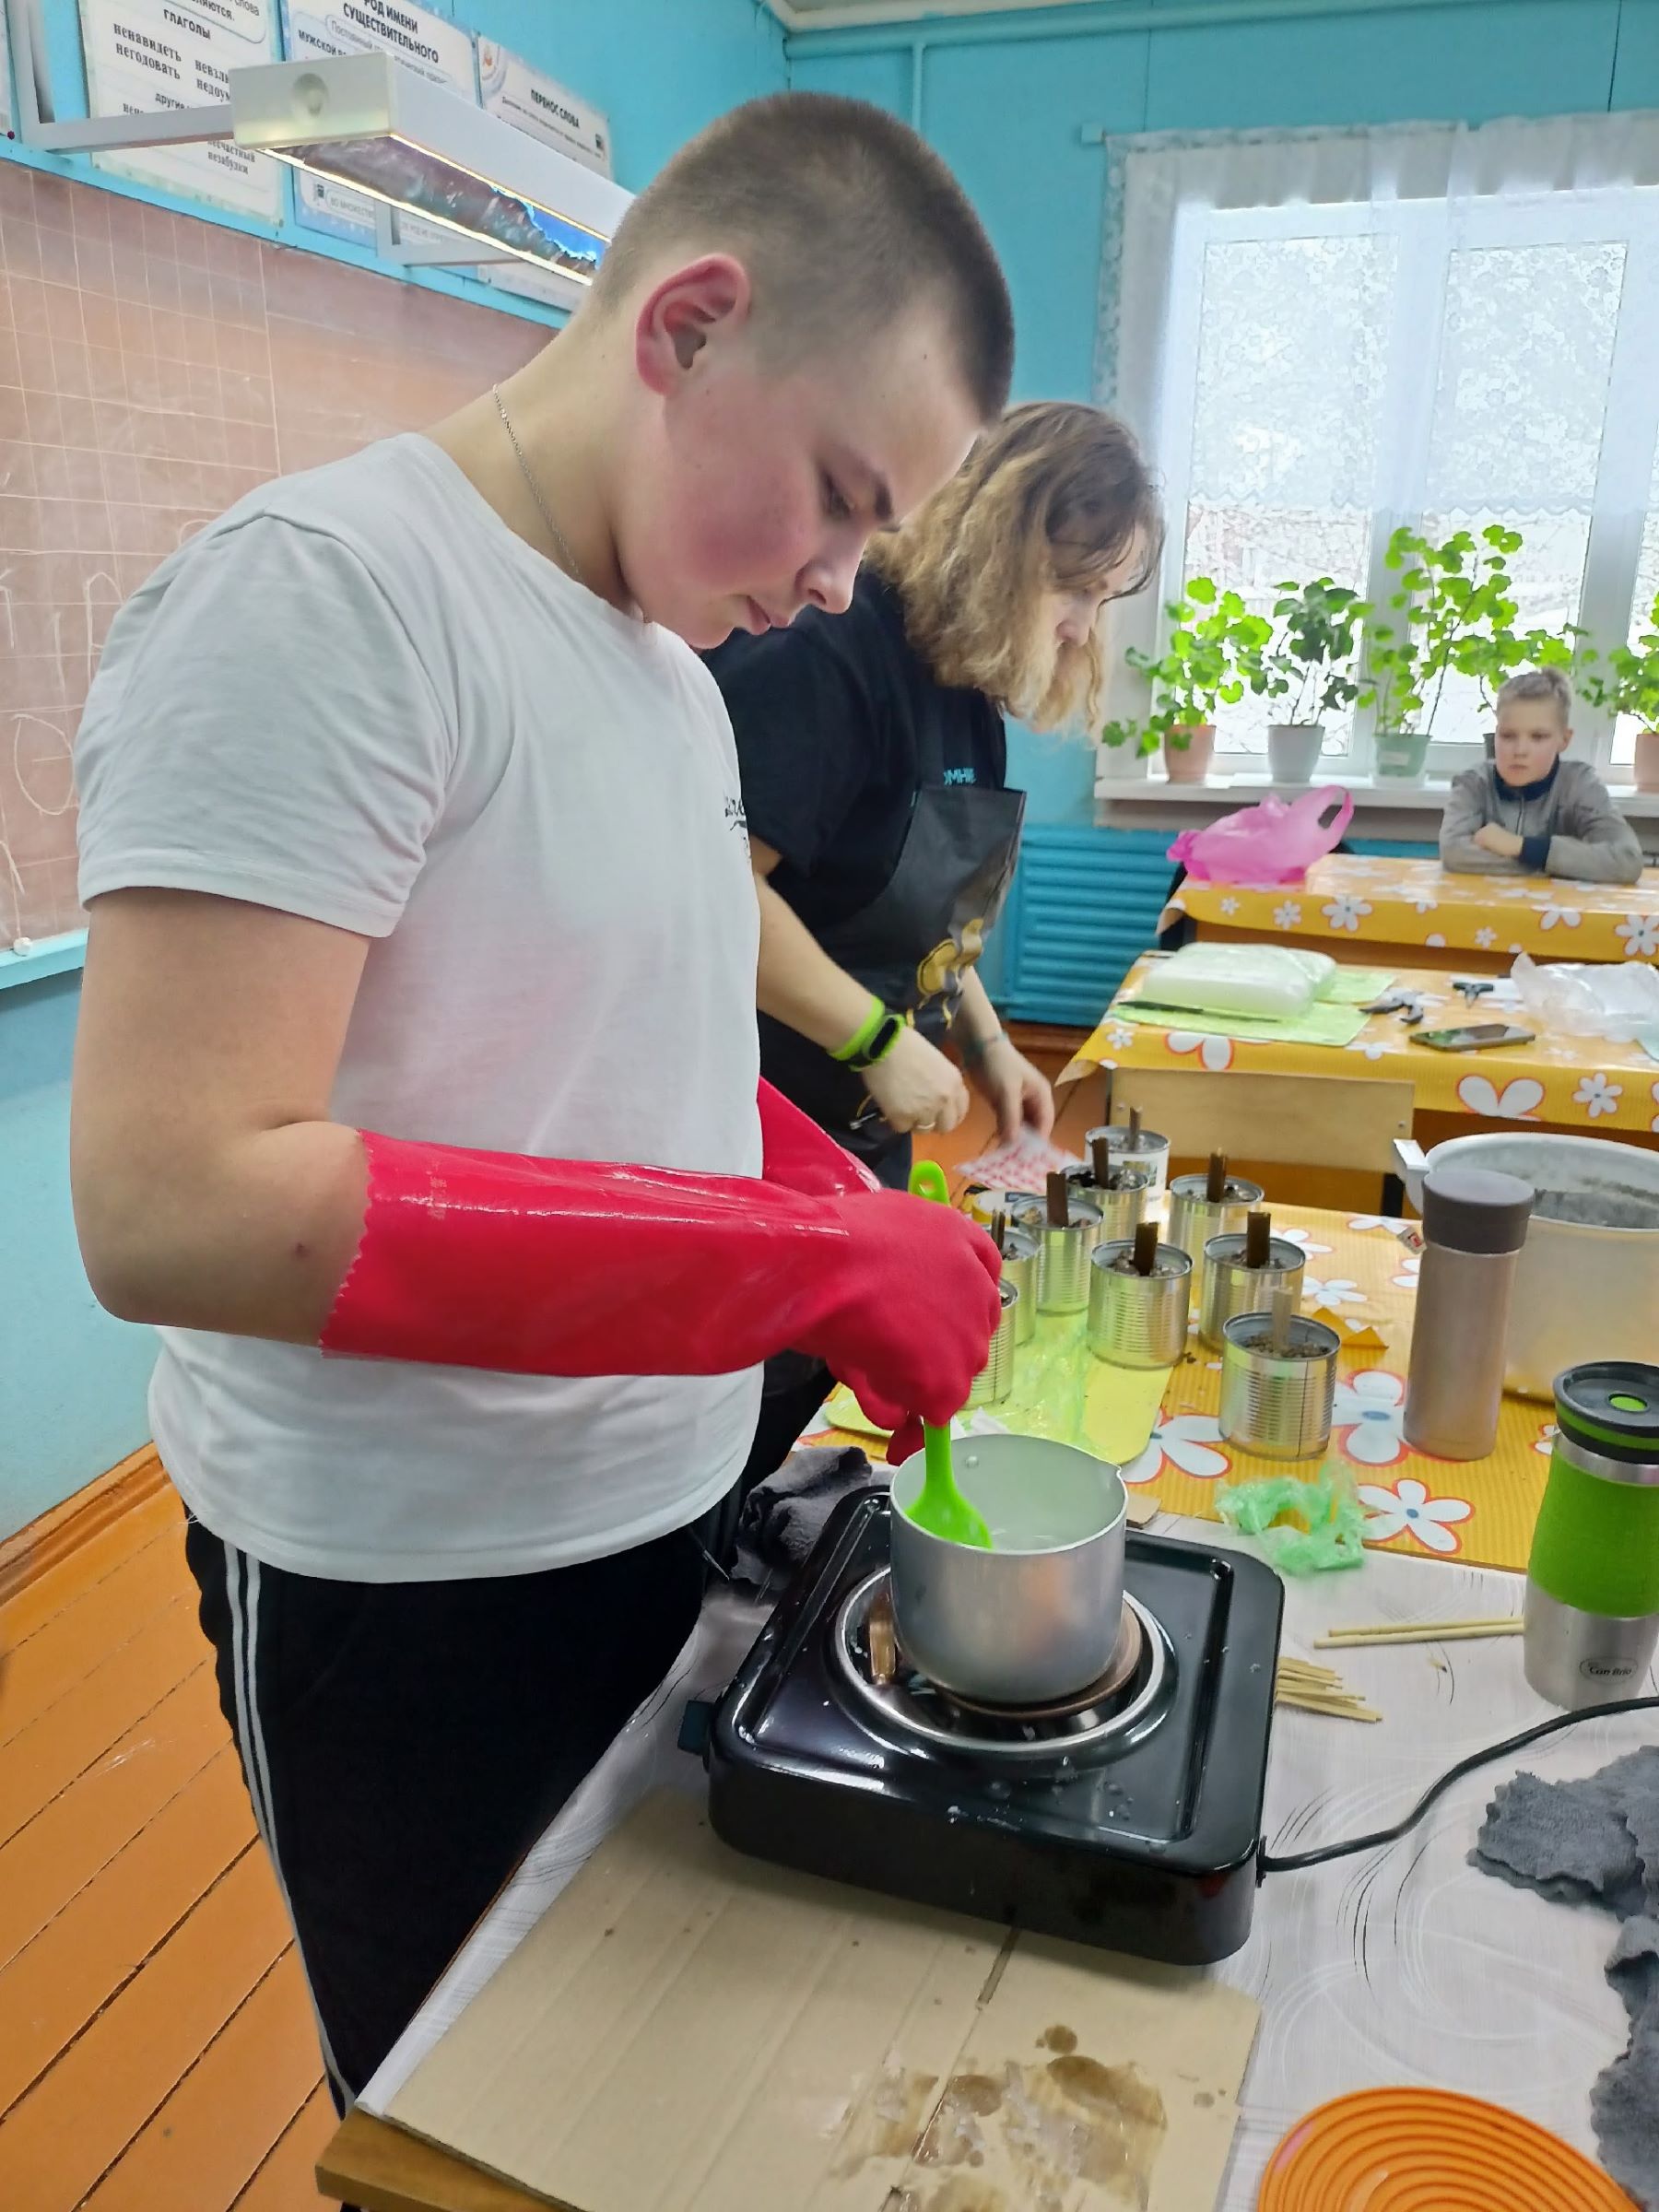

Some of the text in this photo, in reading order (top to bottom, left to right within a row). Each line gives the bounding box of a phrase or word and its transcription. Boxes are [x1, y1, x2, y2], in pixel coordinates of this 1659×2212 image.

[163, 9, 211, 40] ГЛАГОЛЫ
[343, 3, 439, 64] СУЩЕСТВИТЕЛЬНОГО
[386, 5, 418, 35] ИМЕНИ
[113, 23, 182, 63] ненавидеть
[115, 42, 181, 80] негодовать
[559, 108, 581, 129] СЛОВА
